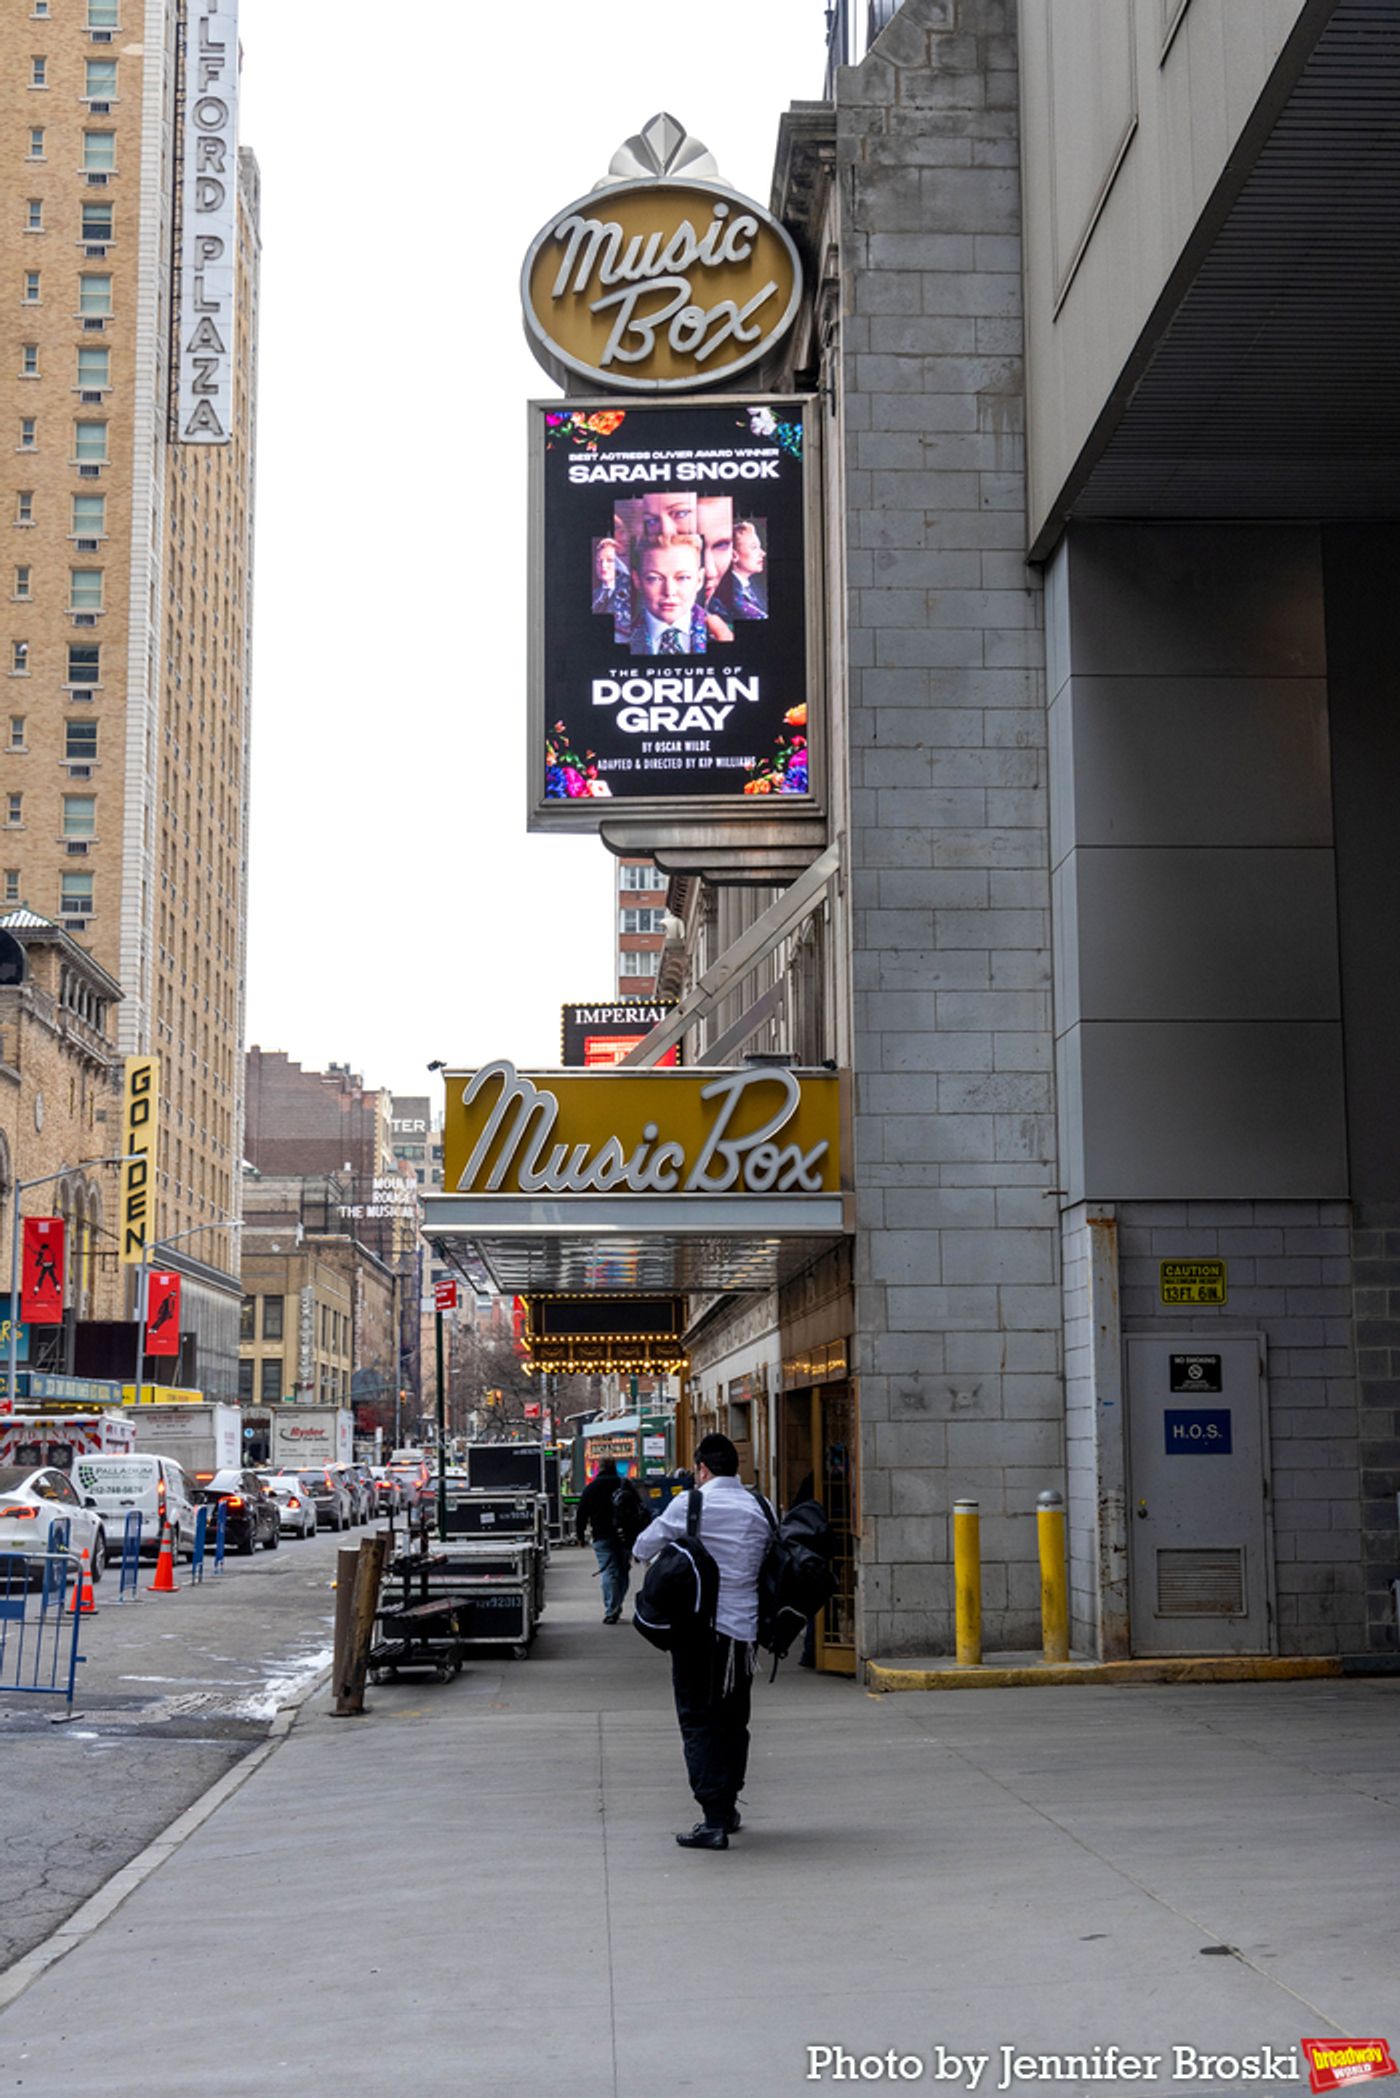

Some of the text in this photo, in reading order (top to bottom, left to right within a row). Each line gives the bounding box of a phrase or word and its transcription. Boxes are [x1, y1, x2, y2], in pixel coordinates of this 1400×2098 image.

[552, 202, 759, 298] Music
[589, 276, 779, 366] Box
[185, 235, 226, 436] PLAZA
[568, 448, 779, 461] BEST ACTRESS OLIVIER AWARD WINNER
[568, 460, 780, 483] SARAH SNOOK
[609, 666, 742, 677] THE PICTURE OF
[592, 676, 759, 705] DORIAN
[616, 705, 735, 733] GRAY
[642, 740, 711, 752] BY OSCAR WILDE
[597, 756, 757, 770] ADAPTED & DIRECTED BY KIP WILLIAMS
[457, 1059, 829, 1192] Music Box
[126, 1065, 151, 1255] GOLDEN
[338, 1205, 415, 1218] THE MUSIAL
[1165, 1266, 1220, 1276] CAUTION
[290, 1426, 325, 1438] Ryder
[1173, 1424, 1223, 1438] H.O.S.
